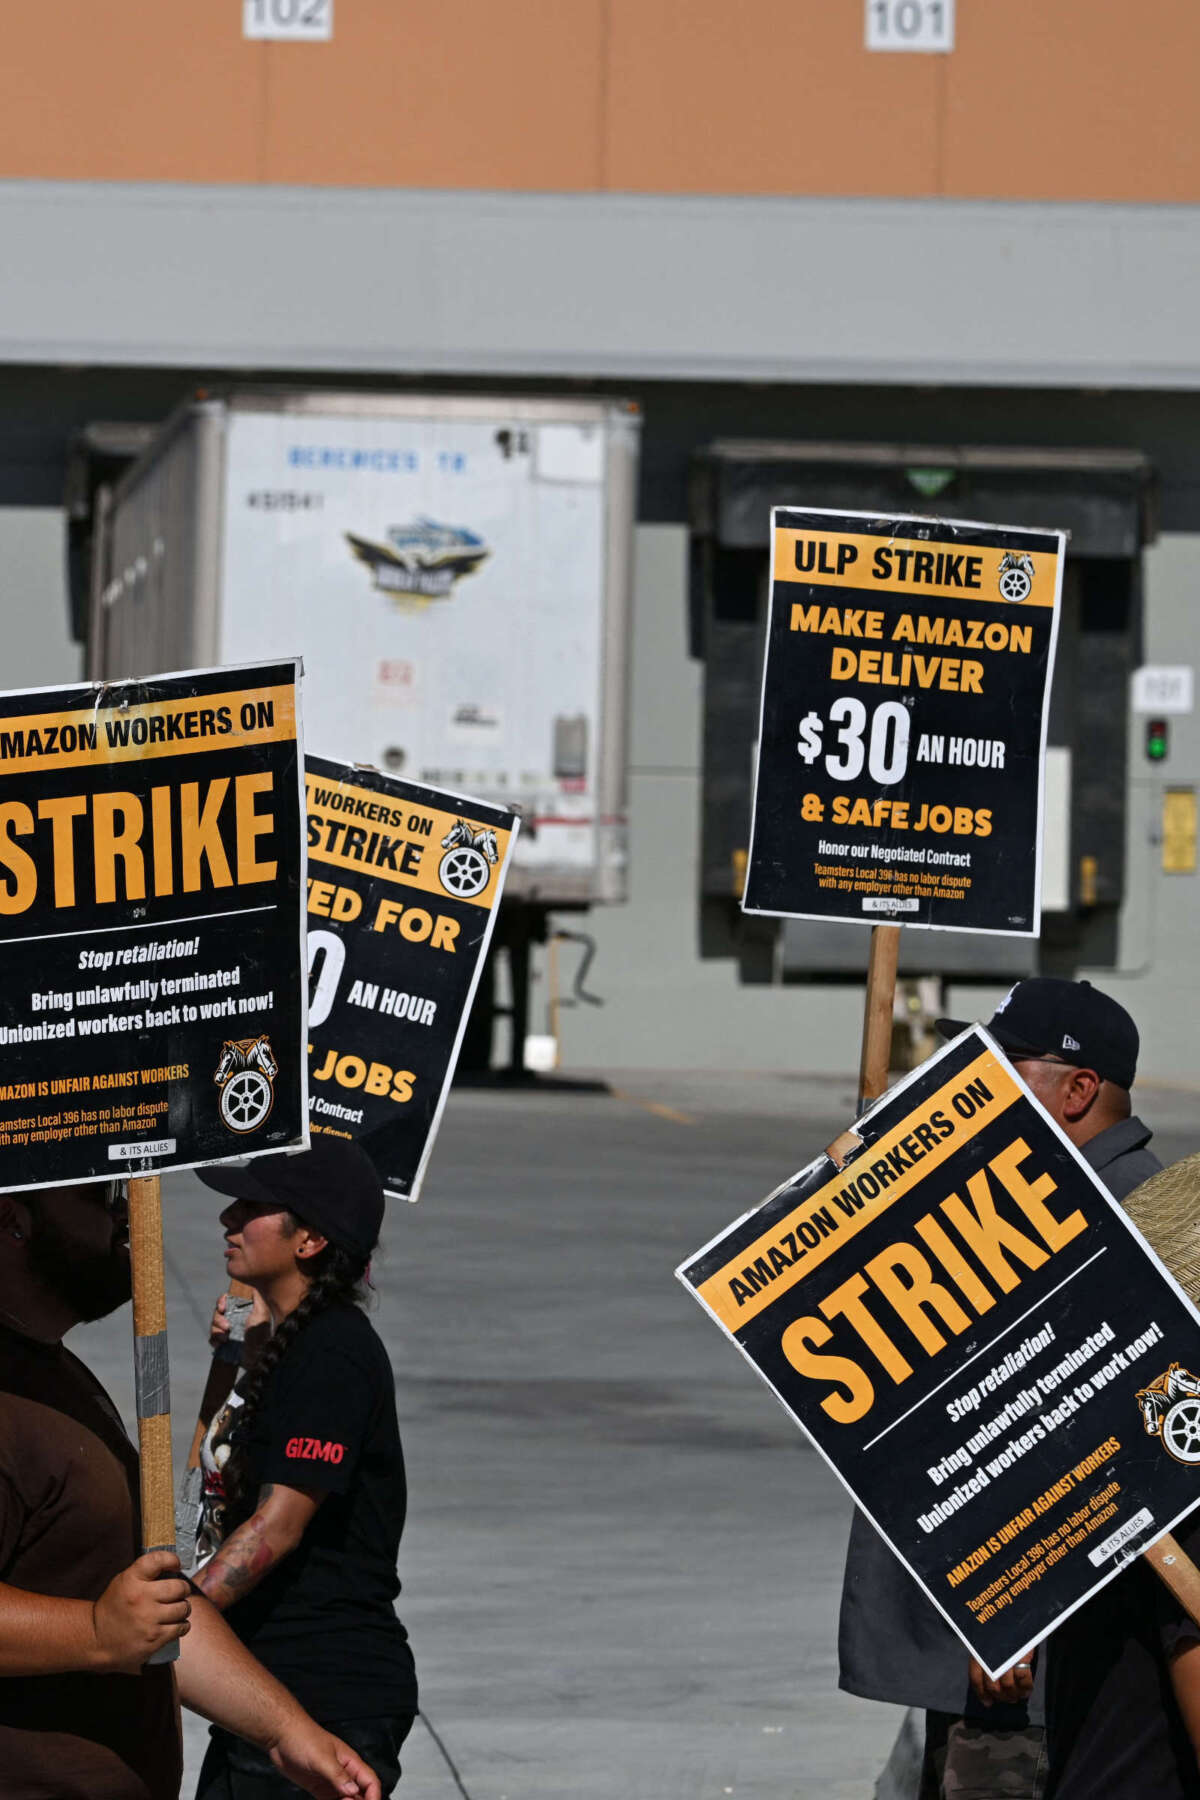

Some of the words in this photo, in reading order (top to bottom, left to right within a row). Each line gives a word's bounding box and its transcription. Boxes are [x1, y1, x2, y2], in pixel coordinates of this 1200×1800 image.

[254, 0, 324, 27] 102
[872, 0, 944, 38] 101
[794, 540, 858, 574] ULP
[871, 548, 983, 589] STRIKE
[790, 603, 885, 639] MAKE
[892, 614, 1033, 654] AMAZON
[830, 647, 984, 694] DELIVER
[106, 707, 232, 748] WORKERS
[240, 701, 274, 730] ON
[797, 697, 911, 785] $30
[916, 733, 944, 765] AN
[949, 737, 1006, 769] HOUR
[315, 788, 402, 827] WORKERS
[407, 815, 433, 836] ON
[801, 793, 824, 822] &
[831, 796, 909, 830] SAFE
[913, 804, 993, 837] JOBS
[307, 814, 425, 877] STRIKE
[818, 840, 849, 856] Honor
[851, 846, 869, 858] our
[871, 845, 925, 864] Negotiated
[927, 850, 971, 867] Contract
[814, 863, 854, 878] Teamsters
[855, 867, 877, 879] Local
[910, 873, 918, 883] no
[920, 873, 939, 885] labor
[941, 874, 972, 888] dispute
[819, 877, 836, 888] with
[838, 881, 853, 892] any
[854, 880, 891, 895] employer
[892, 883, 913, 895] other
[914, 885, 931, 896] than
[933, 887, 964, 899] Amazon
[373, 899, 461, 953] FOR
[78, 951, 113, 970] Stop
[115, 937, 200, 965] retaliation!
[31, 992, 73, 1012] Bring
[76, 981, 159, 1006] unlawfully
[161, 966, 240, 996] terminated
[347, 980, 379, 1010] AN
[379, 987, 438, 1026] HOUR
[77, 1010, 143, 1036] workers
[145, 1006, 181, 1028] back
[182, 1003, 198, 1021] to
[199, 997, 236, 1020] work
[238, 991, 274, 1013] now!
[38, 1082, 49, 1097] IS
[50, 1075, 90, 1095] UNFAIR
[92, 1070, 139, 1090] AGAINST
[140, 1063, 189, 1085] WORKERS
[313, 1050, 417, 1103] JOBS
[12, 1132, 29, 1145] any
[30, 1127, 72, 1144] employer
[74, 1123, 98, 1138] other
[100, 1121, 121, 1135] than
[122, 1116, 156, 1132] Amazon
[38, 1114, 61, 1128] Local
[63, 1111, 79, 1124] 396
[81, 1110, 97, 1122] has
[99, 1110, 111, 1120] no
[112, 1105, 135, 1119] labor
[137, 1101, 169, 1118] dispute
[316, 1098, 364, 1124] Contract
[143, 1142, 169, 1153] ALLIES
[728, 1205, 839, 1306] AMAZON
[830, 1110, 955, 1217] WORKERS
[953, 1077, 995, 1123] ON
[781, 1137, 1089, 1424] STRIKE
[946, 1391, 983, 1422] Stop
[978, 1322, 1057, 1399] retaliation!
[927, 1444, 973, 1486] Bring
[966, 1386, 1044, 1455] unlawfully
[1036, 1321, 1116, 1394] terminated
[285, 1437, 344, 1465] GIZMO
[917, 1468, 991, 1534] Unionized
[985, 1424, 1047, 1479] workers
[1039, 1396, 1080, 1432] back
[1074, 1382, 1094, 1403] to
[1090, 1352, 1131, 1390] work
[1125, 1321, 1165, 1362] now!
[946, 1545, 991, 1588] AMAZON
[985, 1536, 1002, 1555] IS
[996, 1508, 1036, 1545] UNFAIR
[1032, 1474, 1076, 1518] AGAINST
[1071, 1436, 1121, 1483] WORKERS
[966, 1572, 1009, 1613] Teamsters
[1007, 1556, 1031, 1581] Local
[1028, 1543, 1045, 1563] 396
[1042, 1532, 1061, 1551] has
[1058, 1523, 1071, 1537] no
[1067, 1506, 1092, 1531] labor
[1089, 1481, 1121, 1511] dispute
[975, 1605, 997, 1625] with
[996, 1592, 1014, 1609] any
[1012, 1561, 1048, 1597] employer
[1046, 1543, 1070, 1568] other
[1067, 1525, 1088, 1549] than
[1086, 1501, 1119, 1534] Amazon
